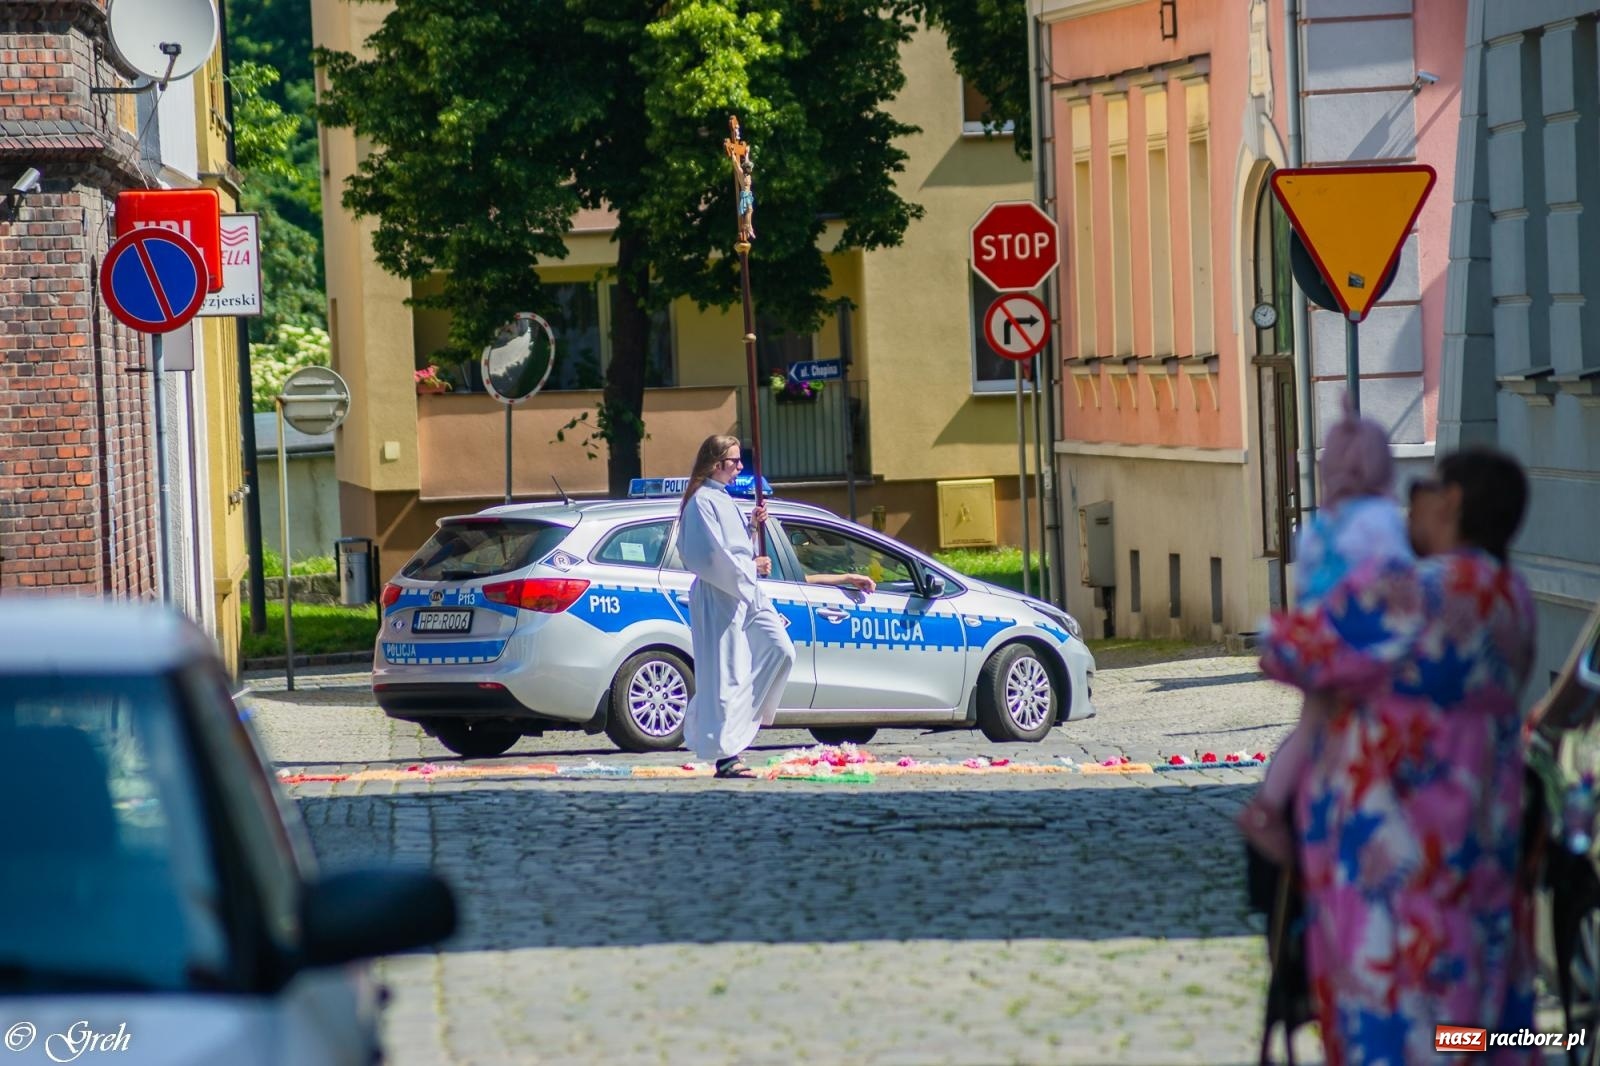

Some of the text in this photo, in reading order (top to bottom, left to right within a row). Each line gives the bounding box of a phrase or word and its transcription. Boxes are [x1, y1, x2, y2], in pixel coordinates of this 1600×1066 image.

[980, 232, 1050, 260] STOP
[458, 593, 475, 605] P113
[589, 595, 620, 613] P113
[851, 617, 924, 642] POLICJA
[386, 644, 416, 656] POLICJA
